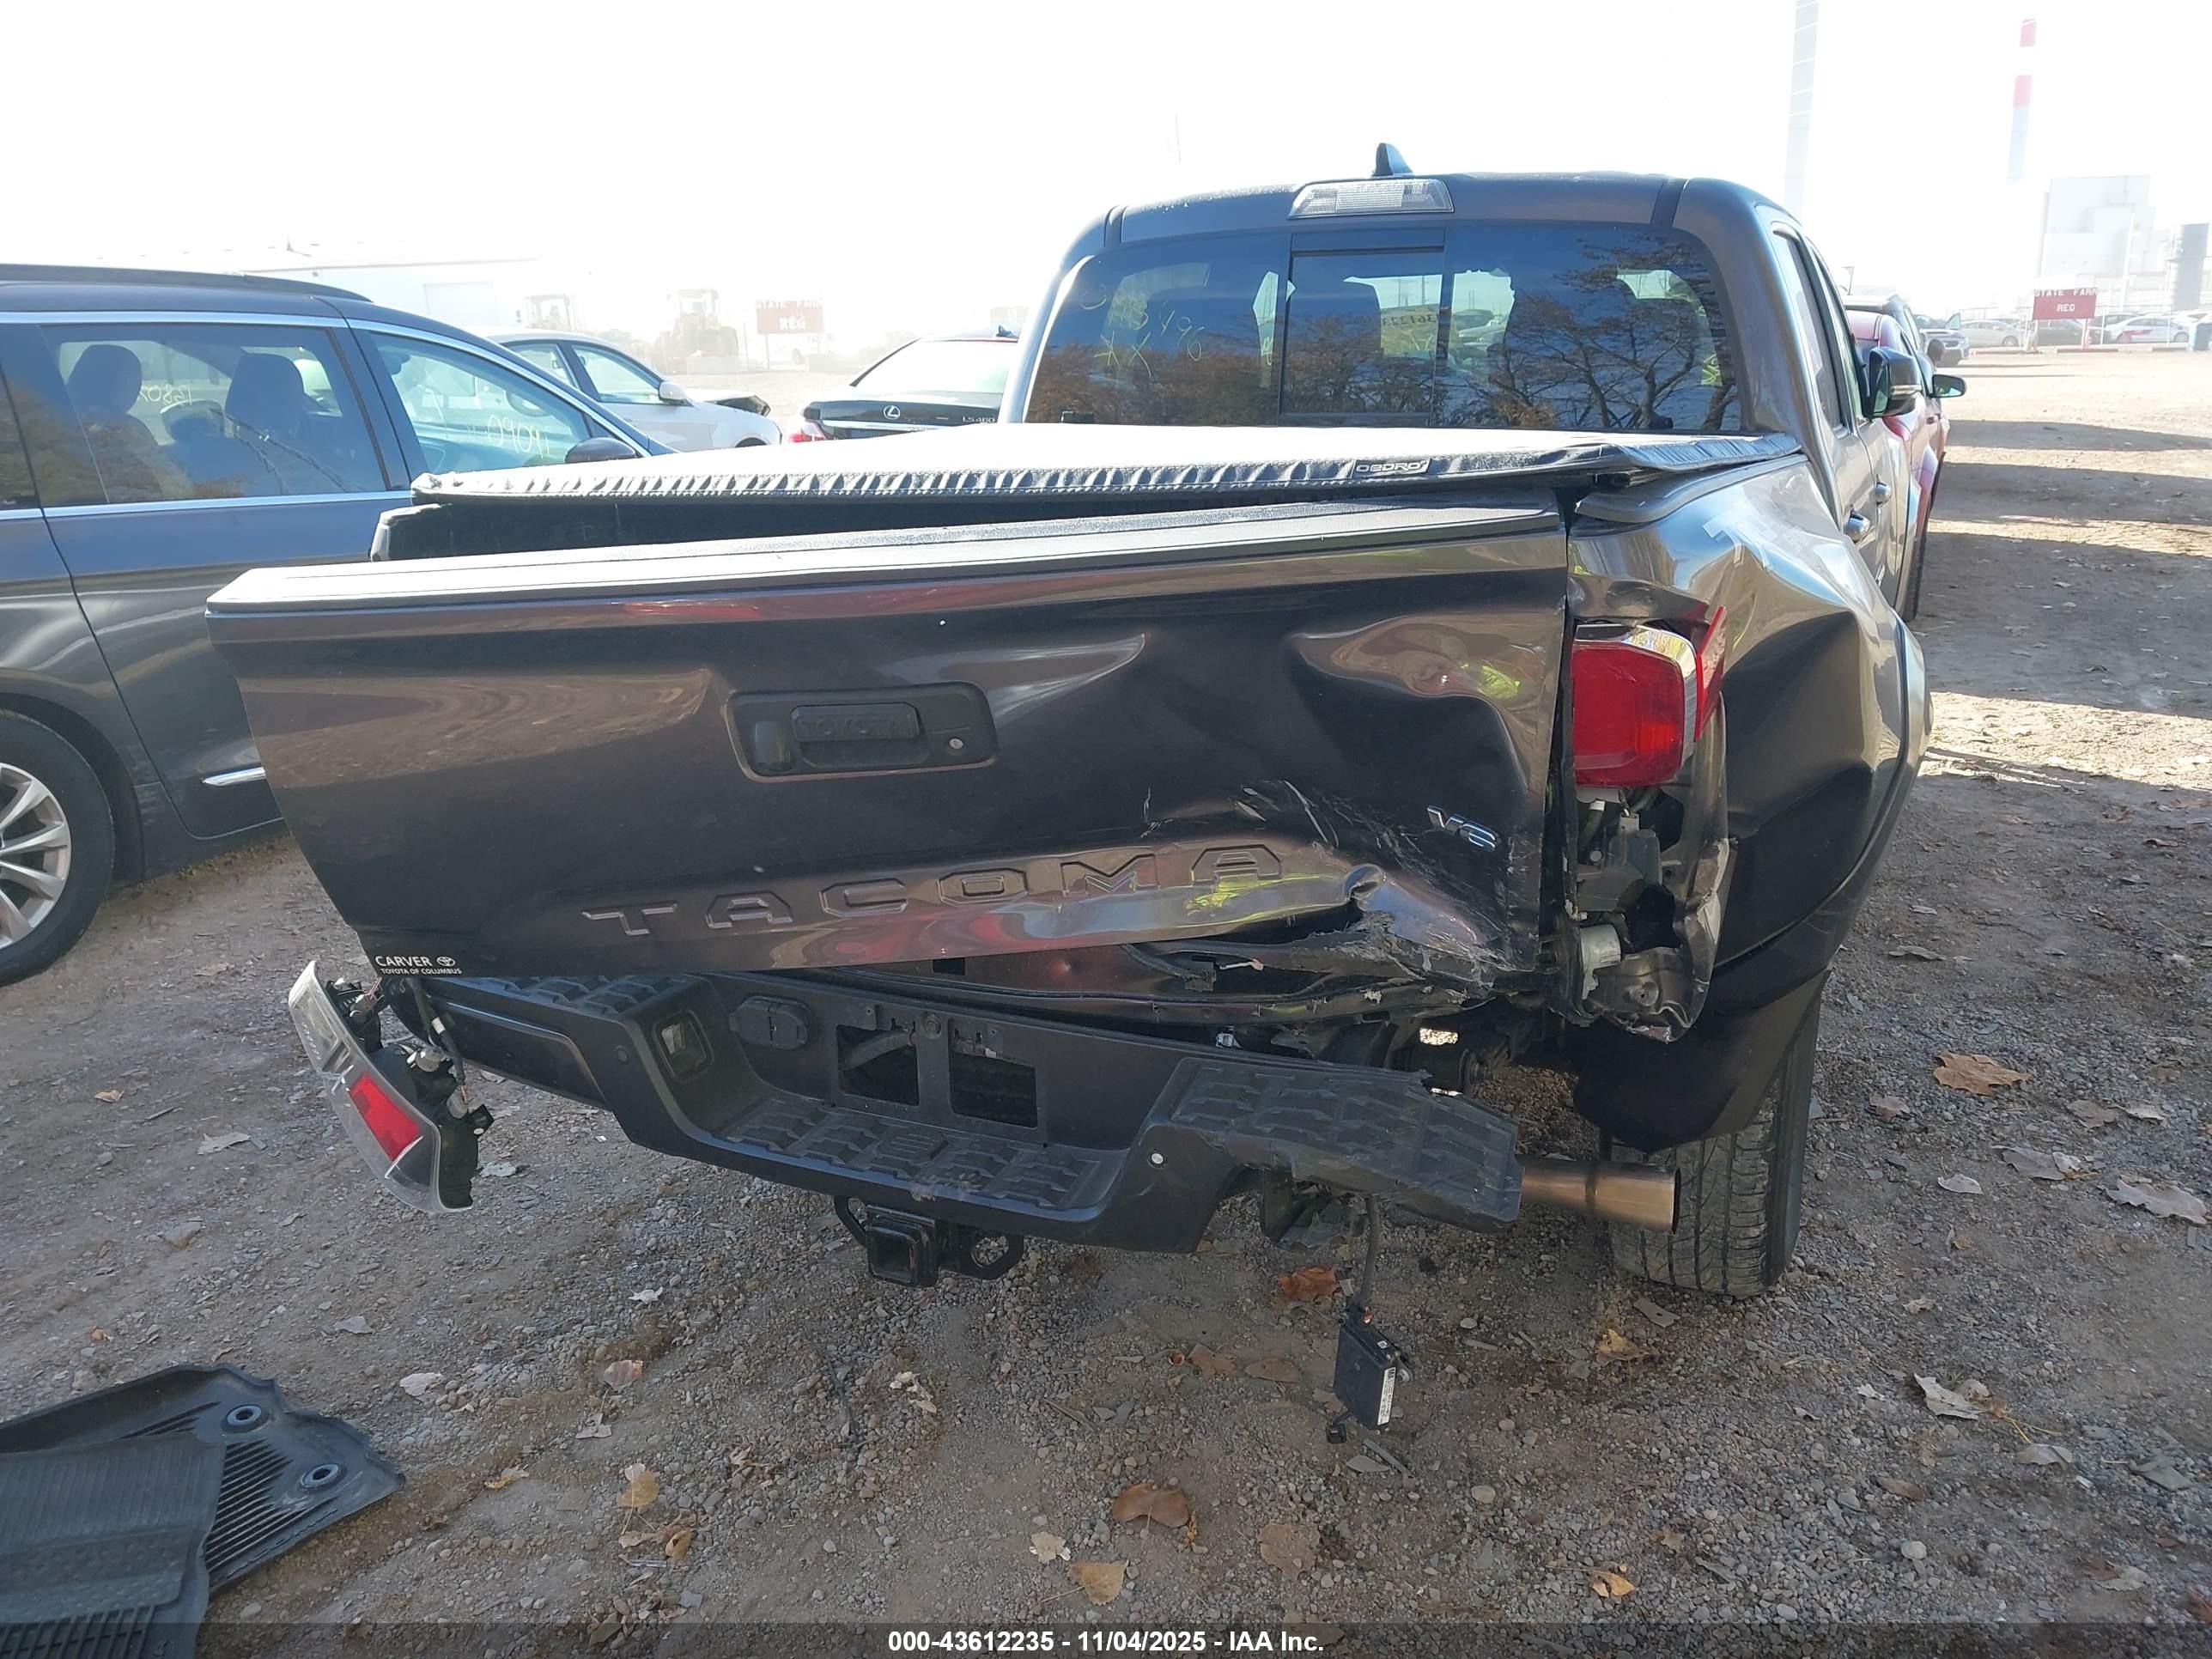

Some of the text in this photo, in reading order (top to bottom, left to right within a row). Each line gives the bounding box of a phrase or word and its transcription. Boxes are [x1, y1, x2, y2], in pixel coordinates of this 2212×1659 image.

[2033, 289, 2064, 297] STATE
[1426, 805, 1500, 852] V6
[581, 843, 1279, 936] TACOMA
[374, 956, 433, 967] CARVER
